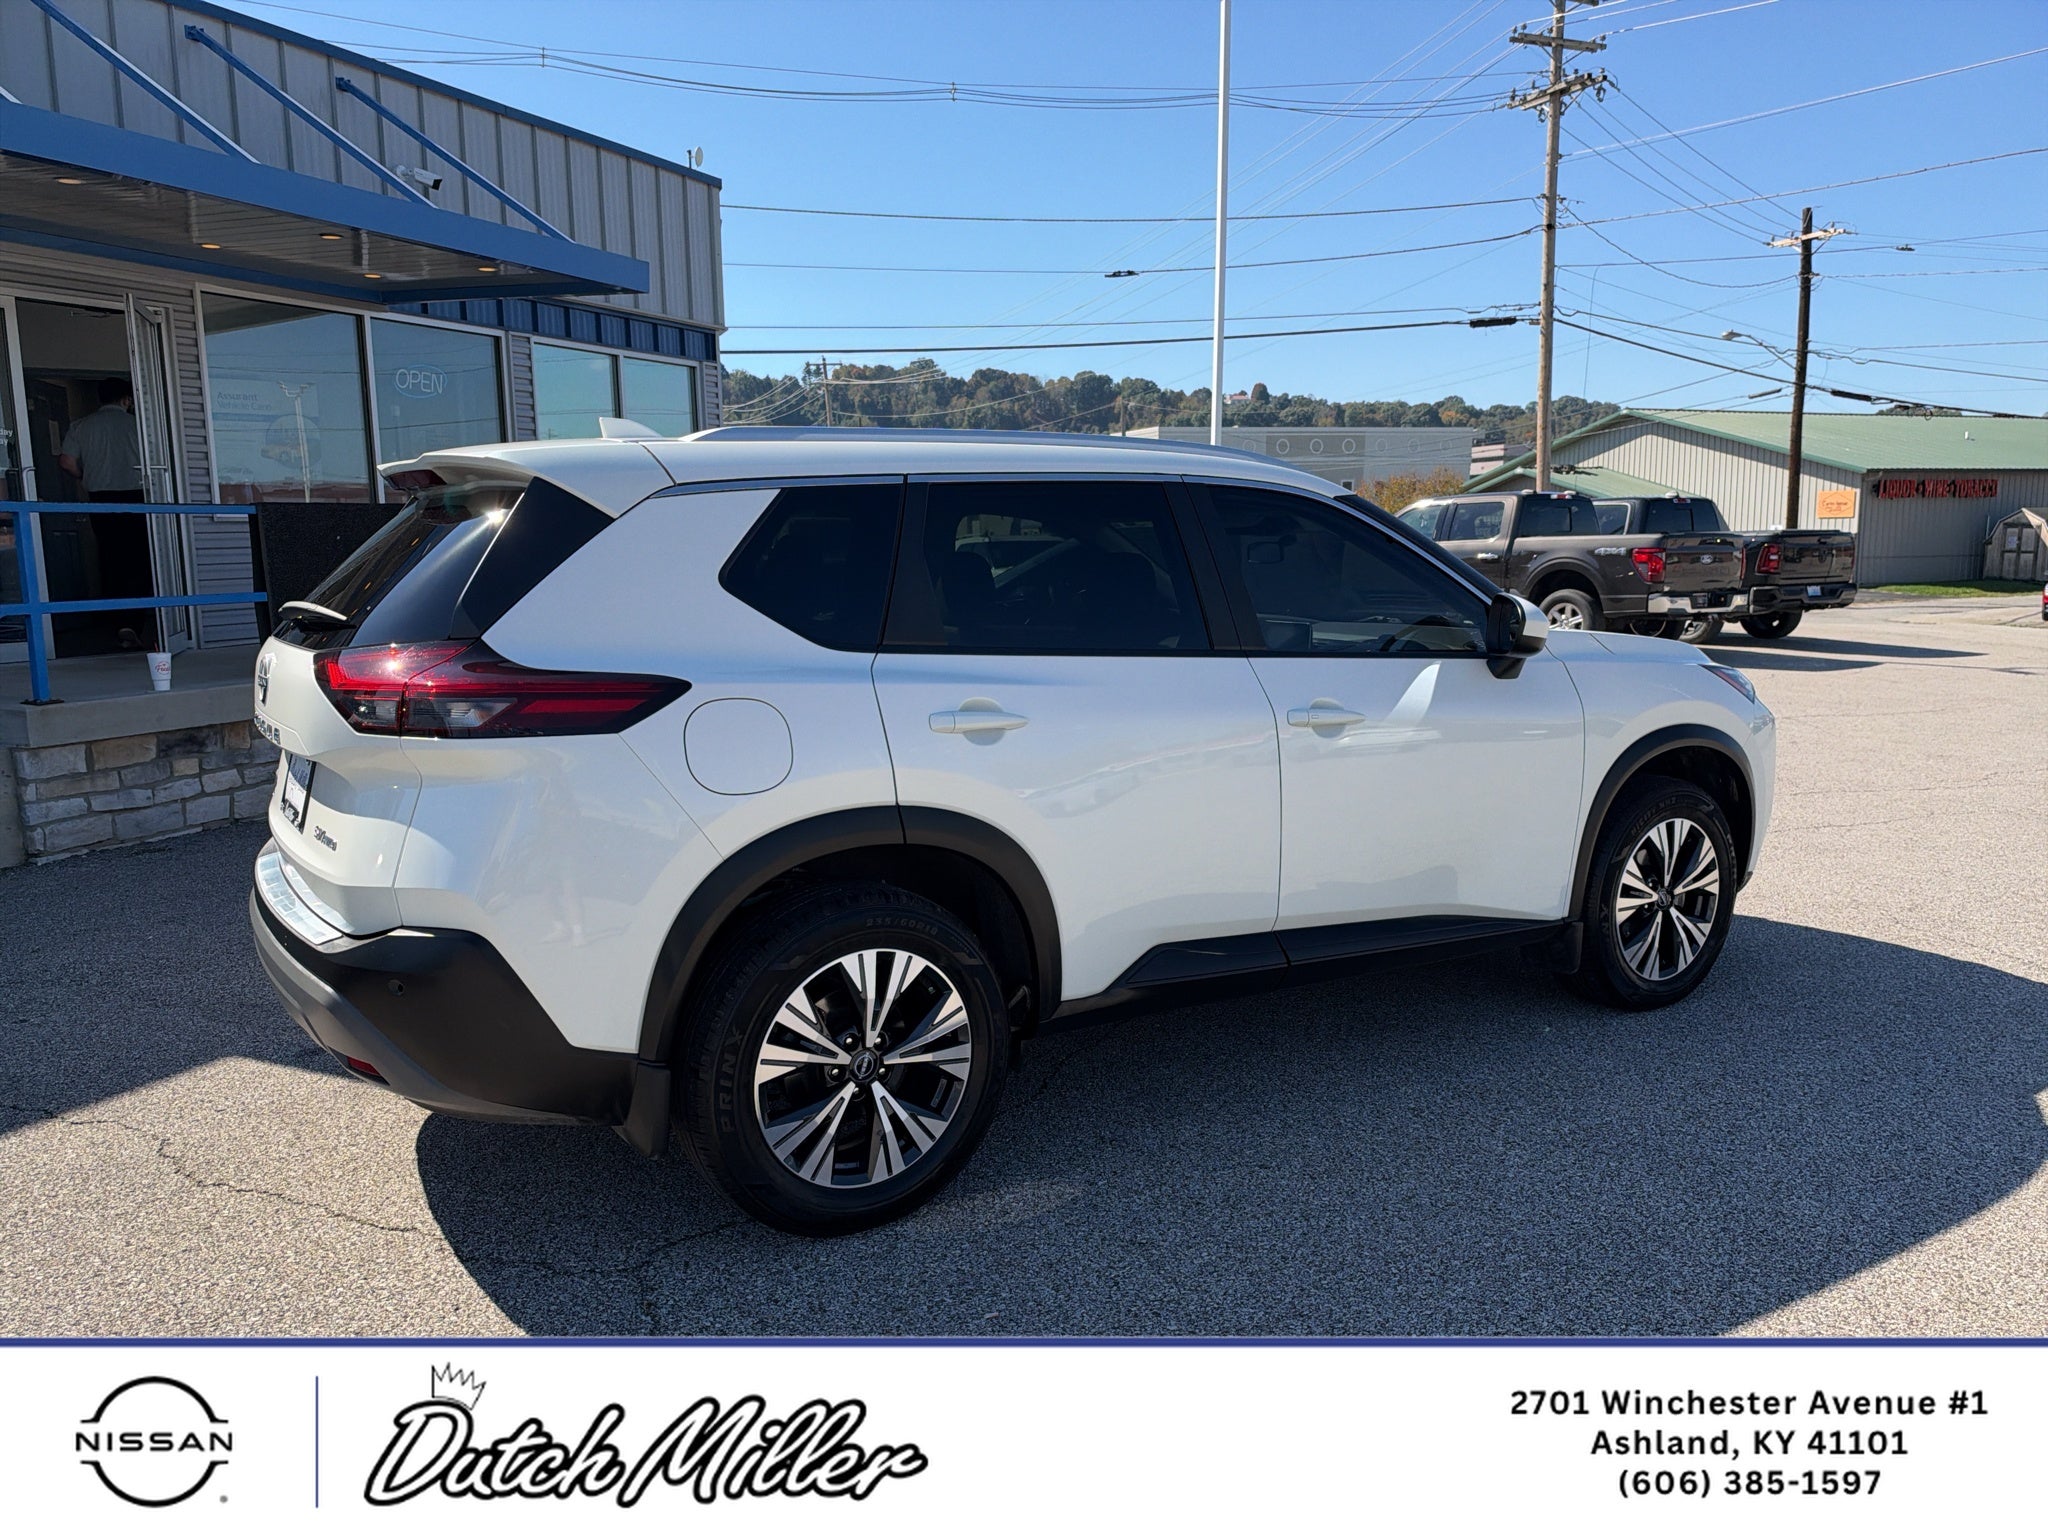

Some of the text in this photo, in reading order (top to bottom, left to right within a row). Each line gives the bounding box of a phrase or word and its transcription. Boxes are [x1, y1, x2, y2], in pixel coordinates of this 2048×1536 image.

[395, 368, 443, 394] OPEN
[1879, 479, 1999, 499] LIQUOR WINE TOBACCO
